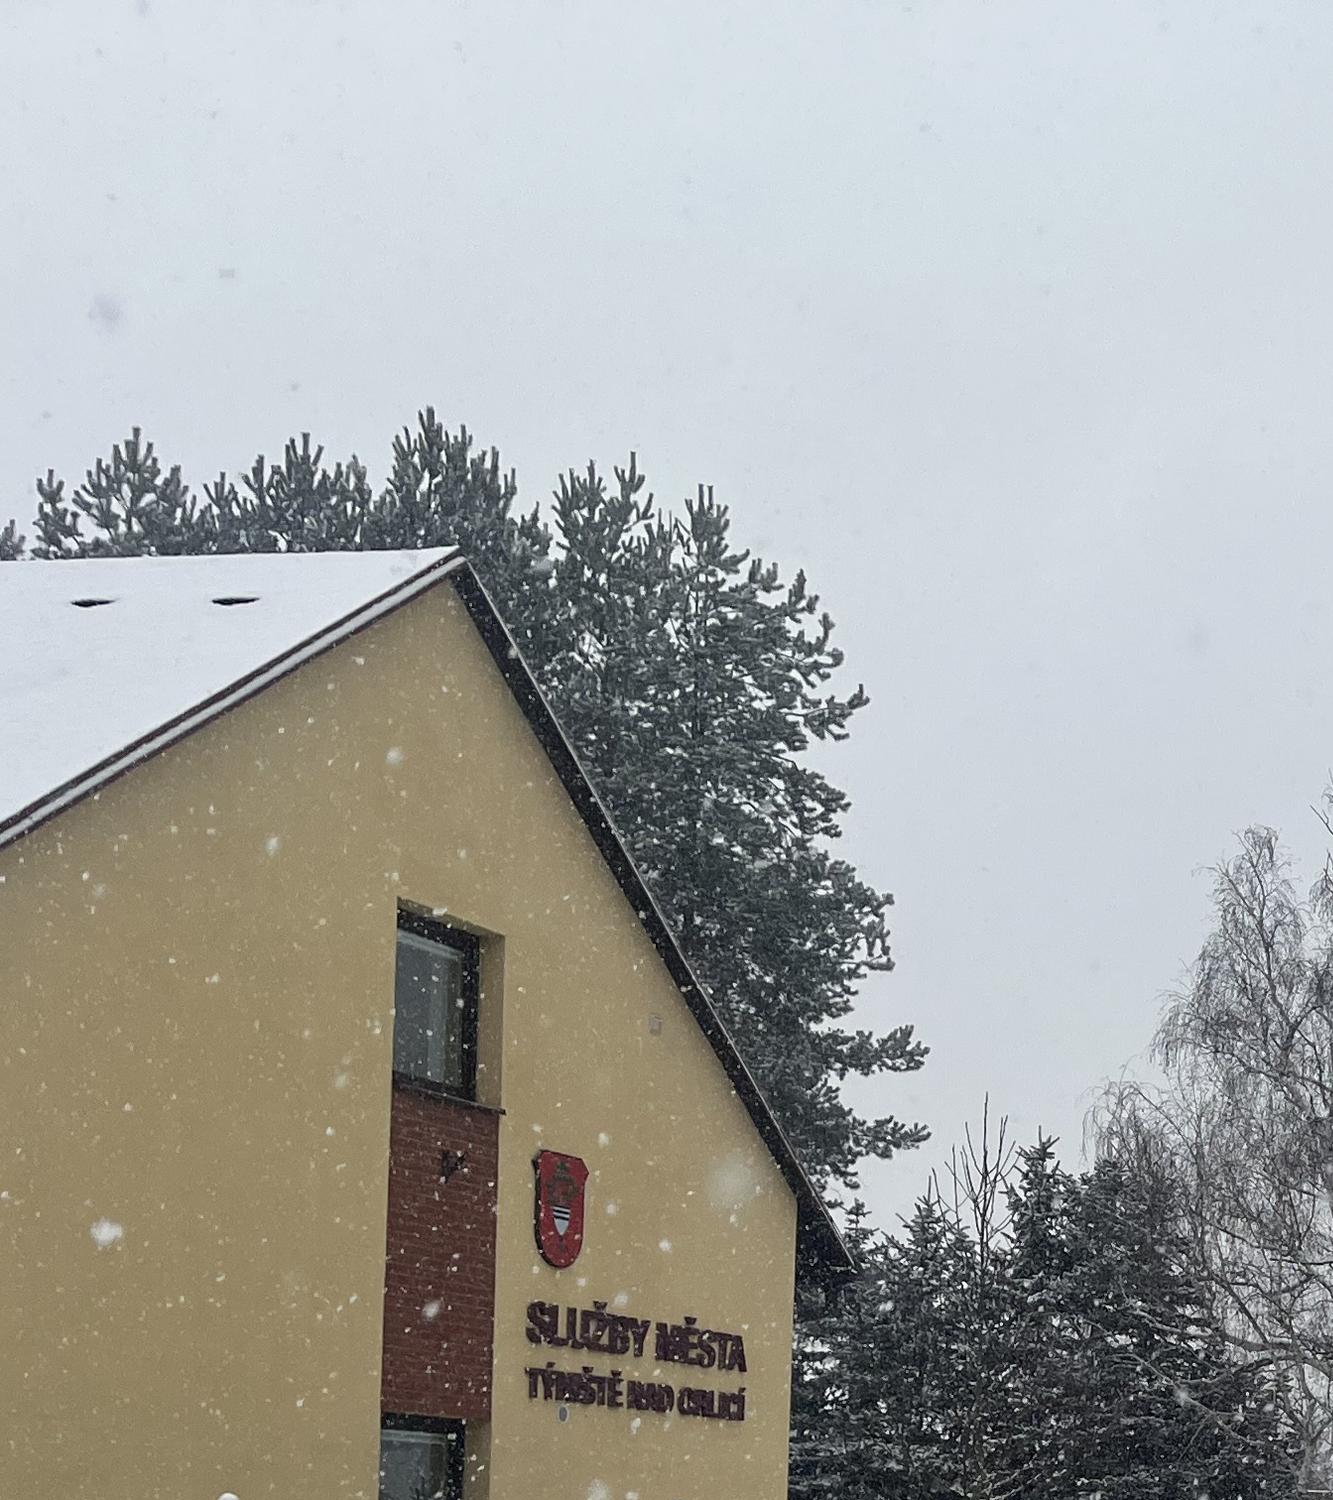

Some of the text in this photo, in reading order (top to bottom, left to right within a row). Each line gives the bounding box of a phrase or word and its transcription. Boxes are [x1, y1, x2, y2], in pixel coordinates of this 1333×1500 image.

[526, 1301, 747, 1372] SLUŽBY MĚSTA
[525, 1361, 746, 1421] TÝNIŠTĚ NAD ORLICÍ
